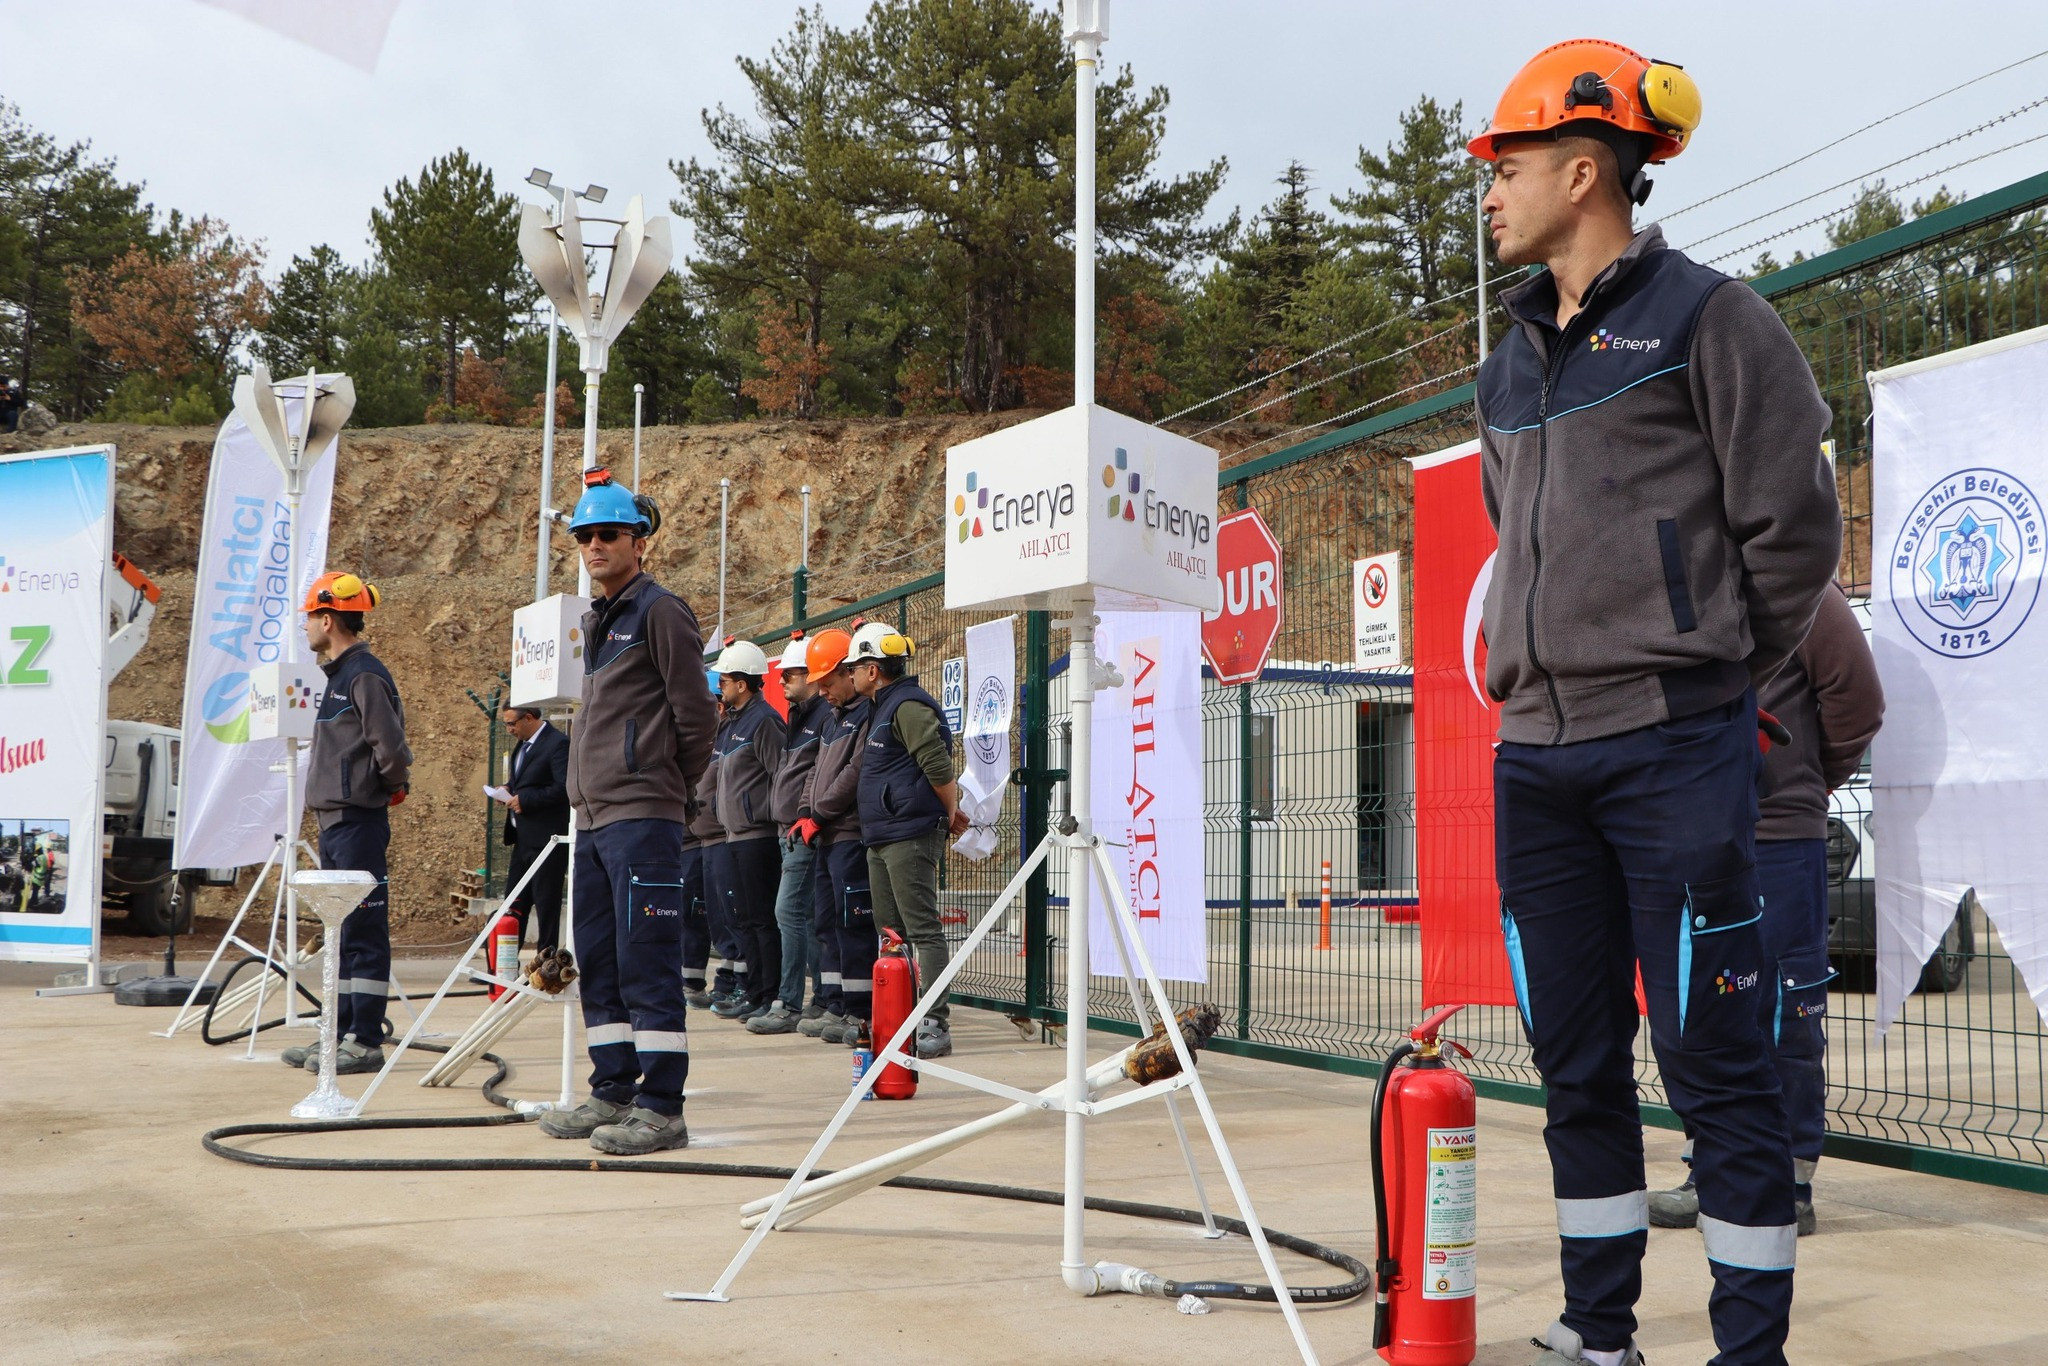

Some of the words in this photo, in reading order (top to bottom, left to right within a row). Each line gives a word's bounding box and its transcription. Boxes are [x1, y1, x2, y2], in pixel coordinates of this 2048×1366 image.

[1612, 337, 1660, 353] Enerya
[992, 483, 1074, 530] Enerya
[1144, 488, 1210, 550] Enerya
[1896, 483, 1957, 569] Beyşehir
[1964, 476, 2042, 555] Belediyesi
[1019, 532, 1070, 560] AHLATCI
[1167, 551, 1206, 576] AHLATCI
[19, 571, 79, 594] Enerya
[1388, 633, 1396, 641] VE
[1940, 629, 1990, 649] 1872
[526, 639, 554, 664] Enerya
[1125, 648, 1160, 925] AHLATCI
